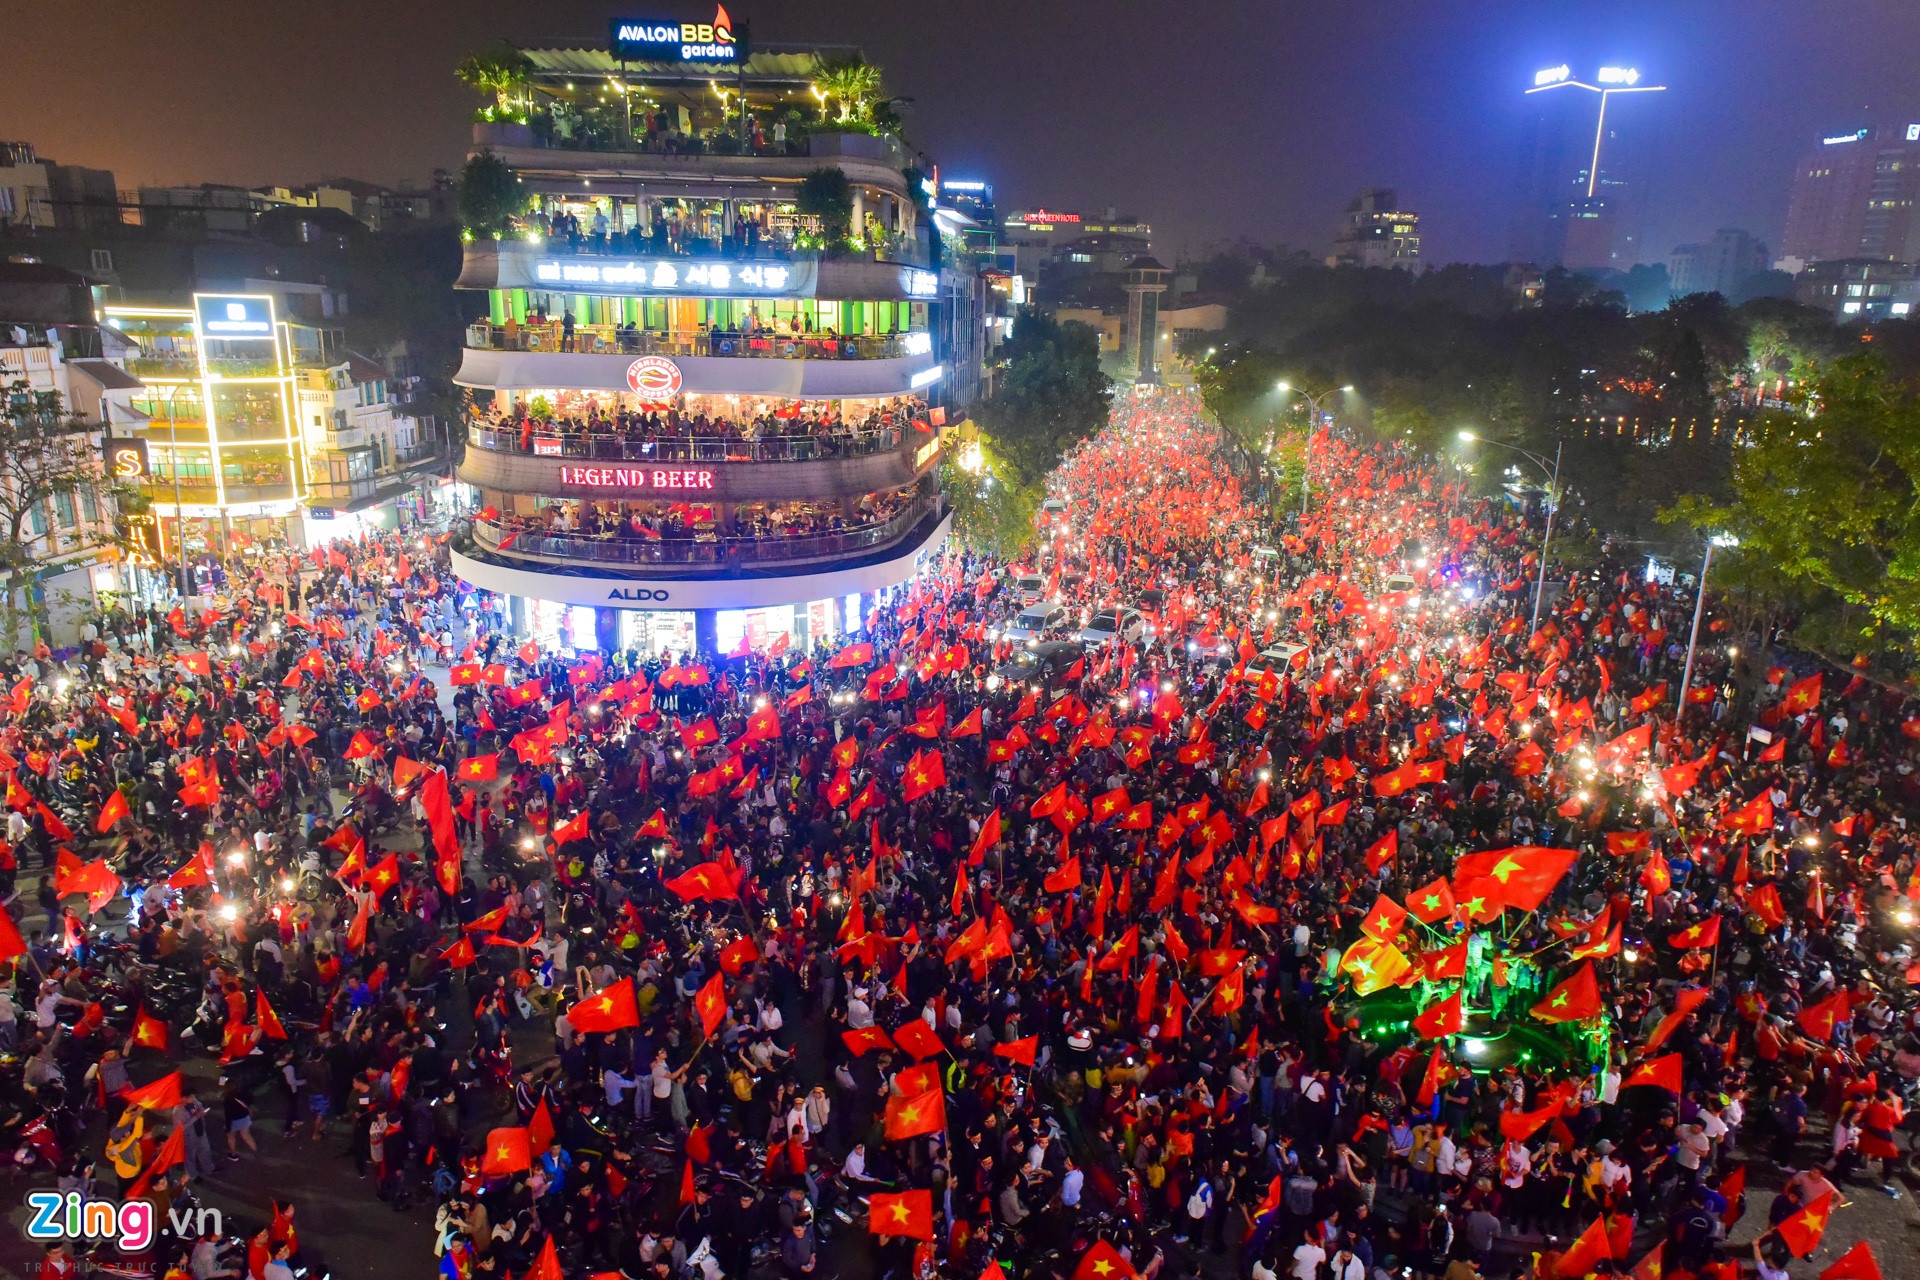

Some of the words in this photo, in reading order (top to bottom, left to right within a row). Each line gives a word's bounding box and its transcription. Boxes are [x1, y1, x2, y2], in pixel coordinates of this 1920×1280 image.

[618, 25, 679, 42] AVALON
[680, 18, 736, 44] BBQ
[681, 44, 734, 59] garden
[1024, 213, 1038, 222] SILK
[1039, 208, 1060, 224] QUEEN
[1061, 214, 1080, 222] HOTEL
[630, 359, 679, 377] HIGHLANDS
[636, 386, 675, 398] COFFEE
[115, 450, 142, 476] S
[561, 466, 645, 487] LEGEND
[653, 470, 713, 489] BEER
[607, 588, 669, 601] ALDO
